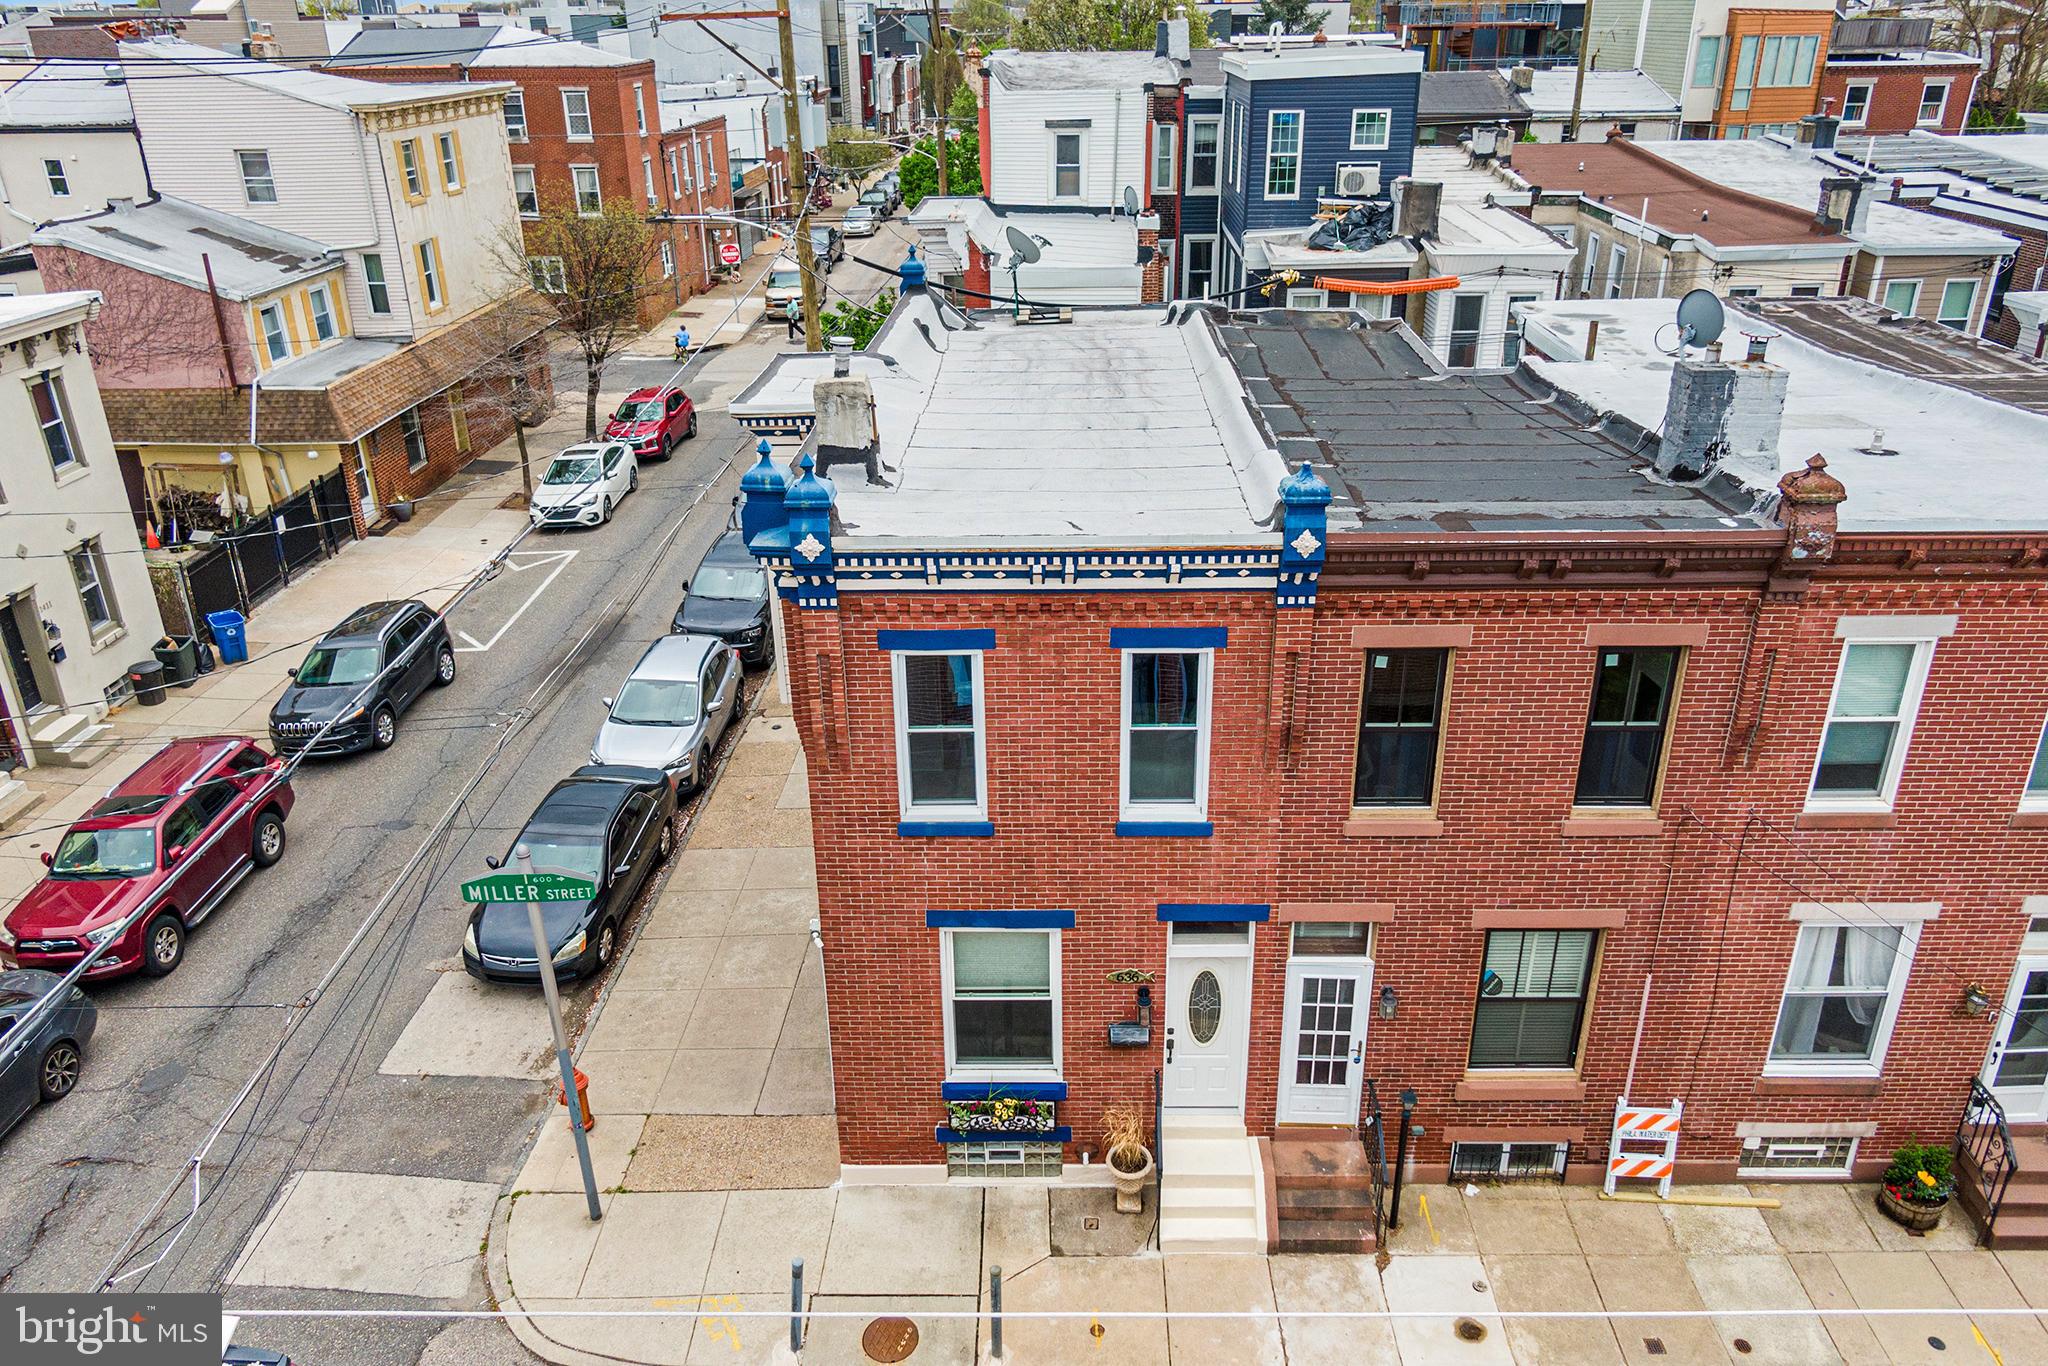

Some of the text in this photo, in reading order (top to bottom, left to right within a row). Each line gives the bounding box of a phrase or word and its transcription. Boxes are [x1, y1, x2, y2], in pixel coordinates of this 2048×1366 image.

[468, 885, 592, 901] MILLER STREET
[1116, 973, 1139, 982] 636
